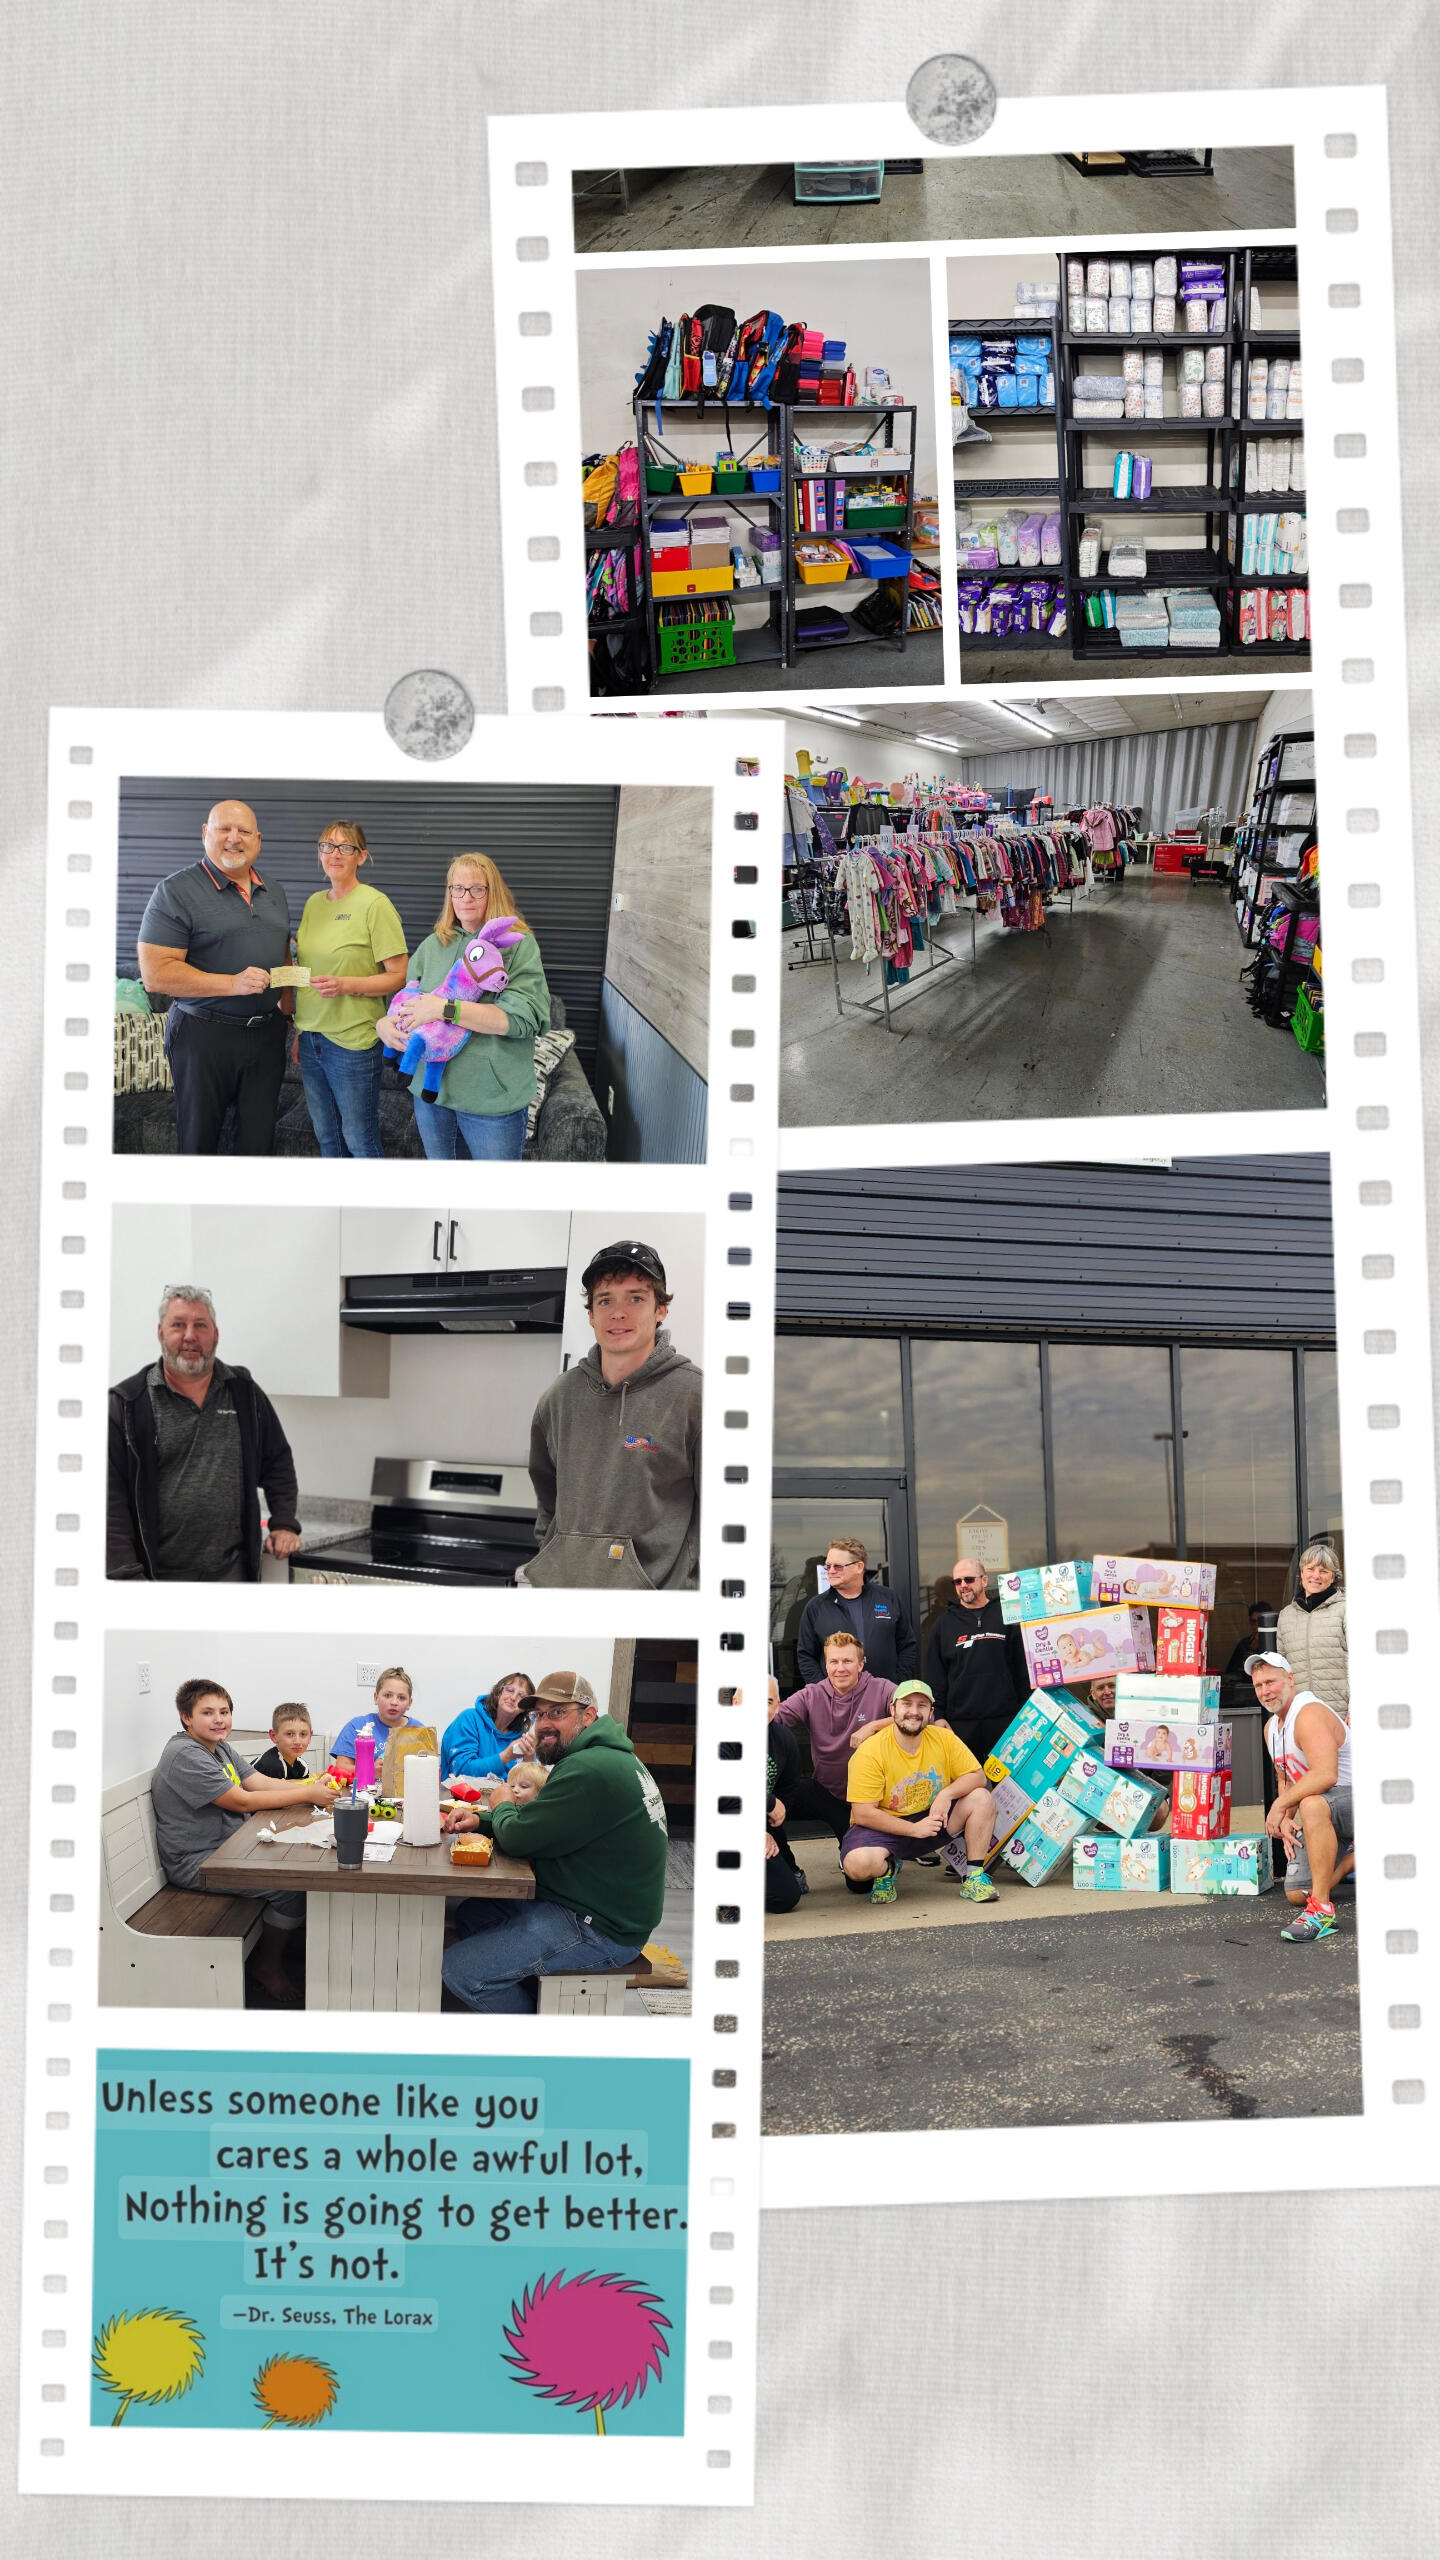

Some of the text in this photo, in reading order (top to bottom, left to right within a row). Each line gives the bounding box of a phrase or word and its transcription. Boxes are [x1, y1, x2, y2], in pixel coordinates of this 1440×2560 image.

[1035, 1641, 1046, 1650] Dry
[1185, 1619, 1197, 1664] HUGGIES
[102, 2079, 538, 2128] Unless someone like you
[216, 2133, 643, 2178] cares a whole awful lot,
[126, 2185, 688, 2242] Nothing is going to get better.
[254, 2240, 399, 2280] It's not.
[343, 2305, 377, 2325] The
[384, 2309, 433, 2325] Lorax
